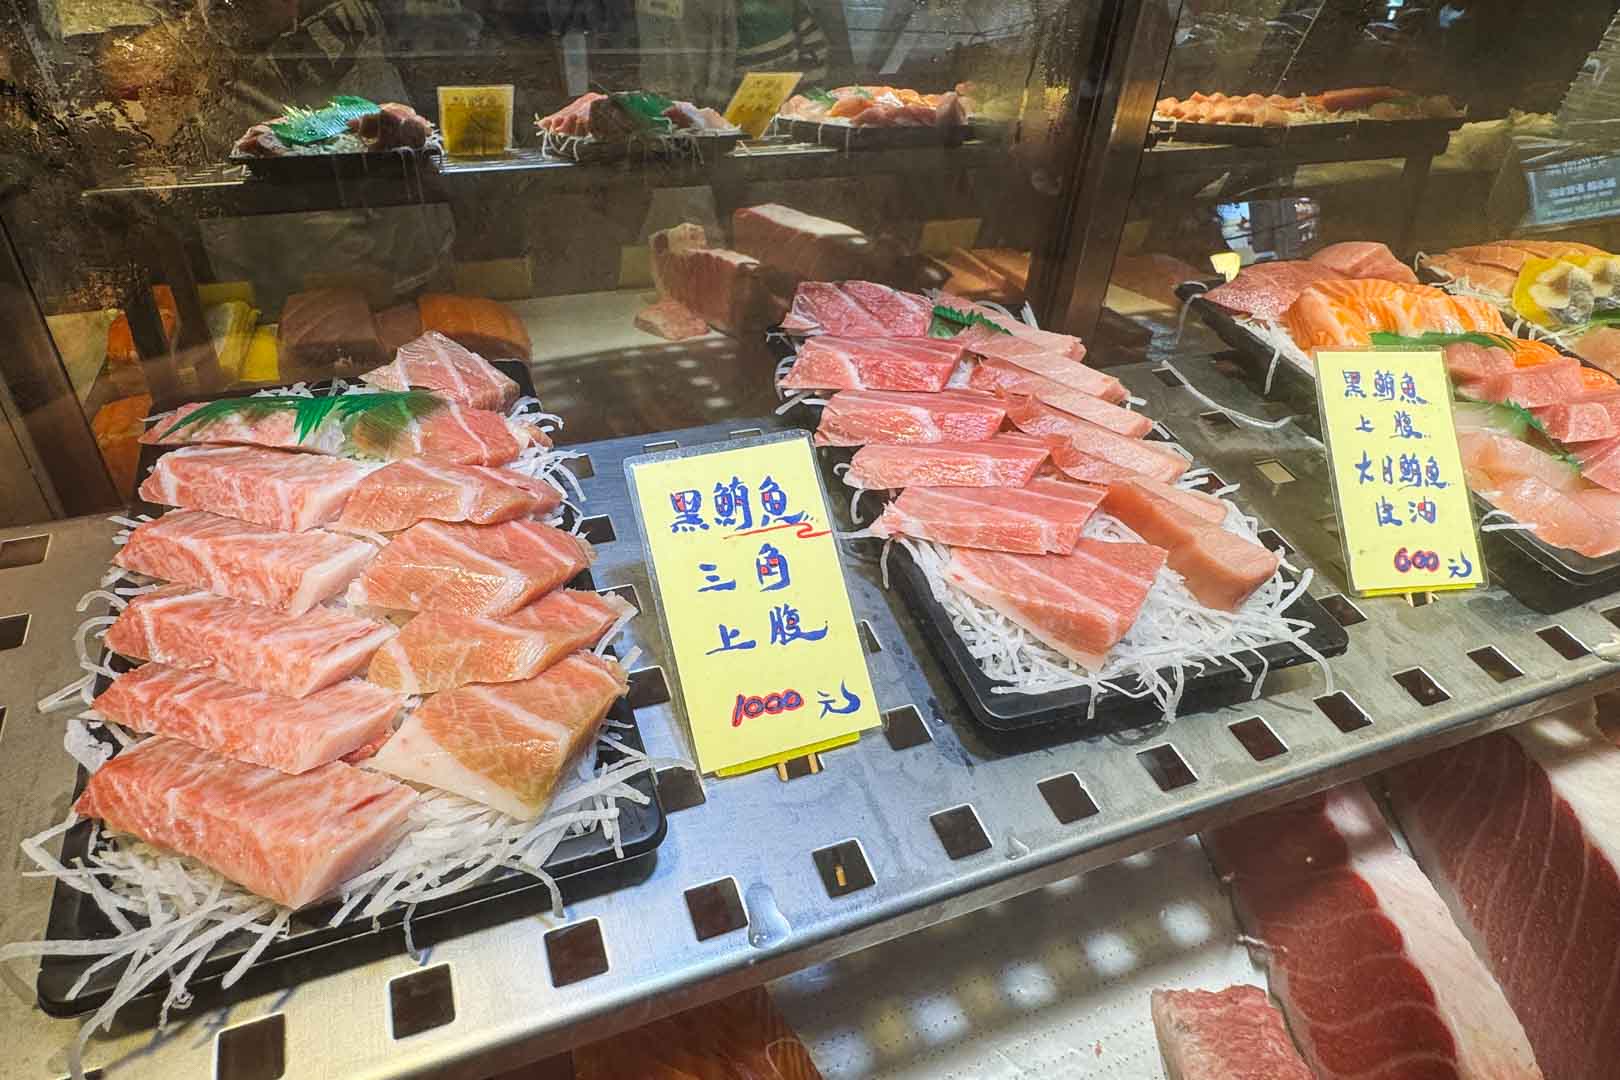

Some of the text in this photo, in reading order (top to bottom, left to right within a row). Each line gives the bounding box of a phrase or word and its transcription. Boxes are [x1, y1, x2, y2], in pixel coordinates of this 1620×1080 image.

[1342, 370, 1428, 404] 黑鮪魚
[670, 476, 816, 531] 黑鮪魚
[697, 543, 791, 592] 三角
[706, 604, 829, 655] 上腹
